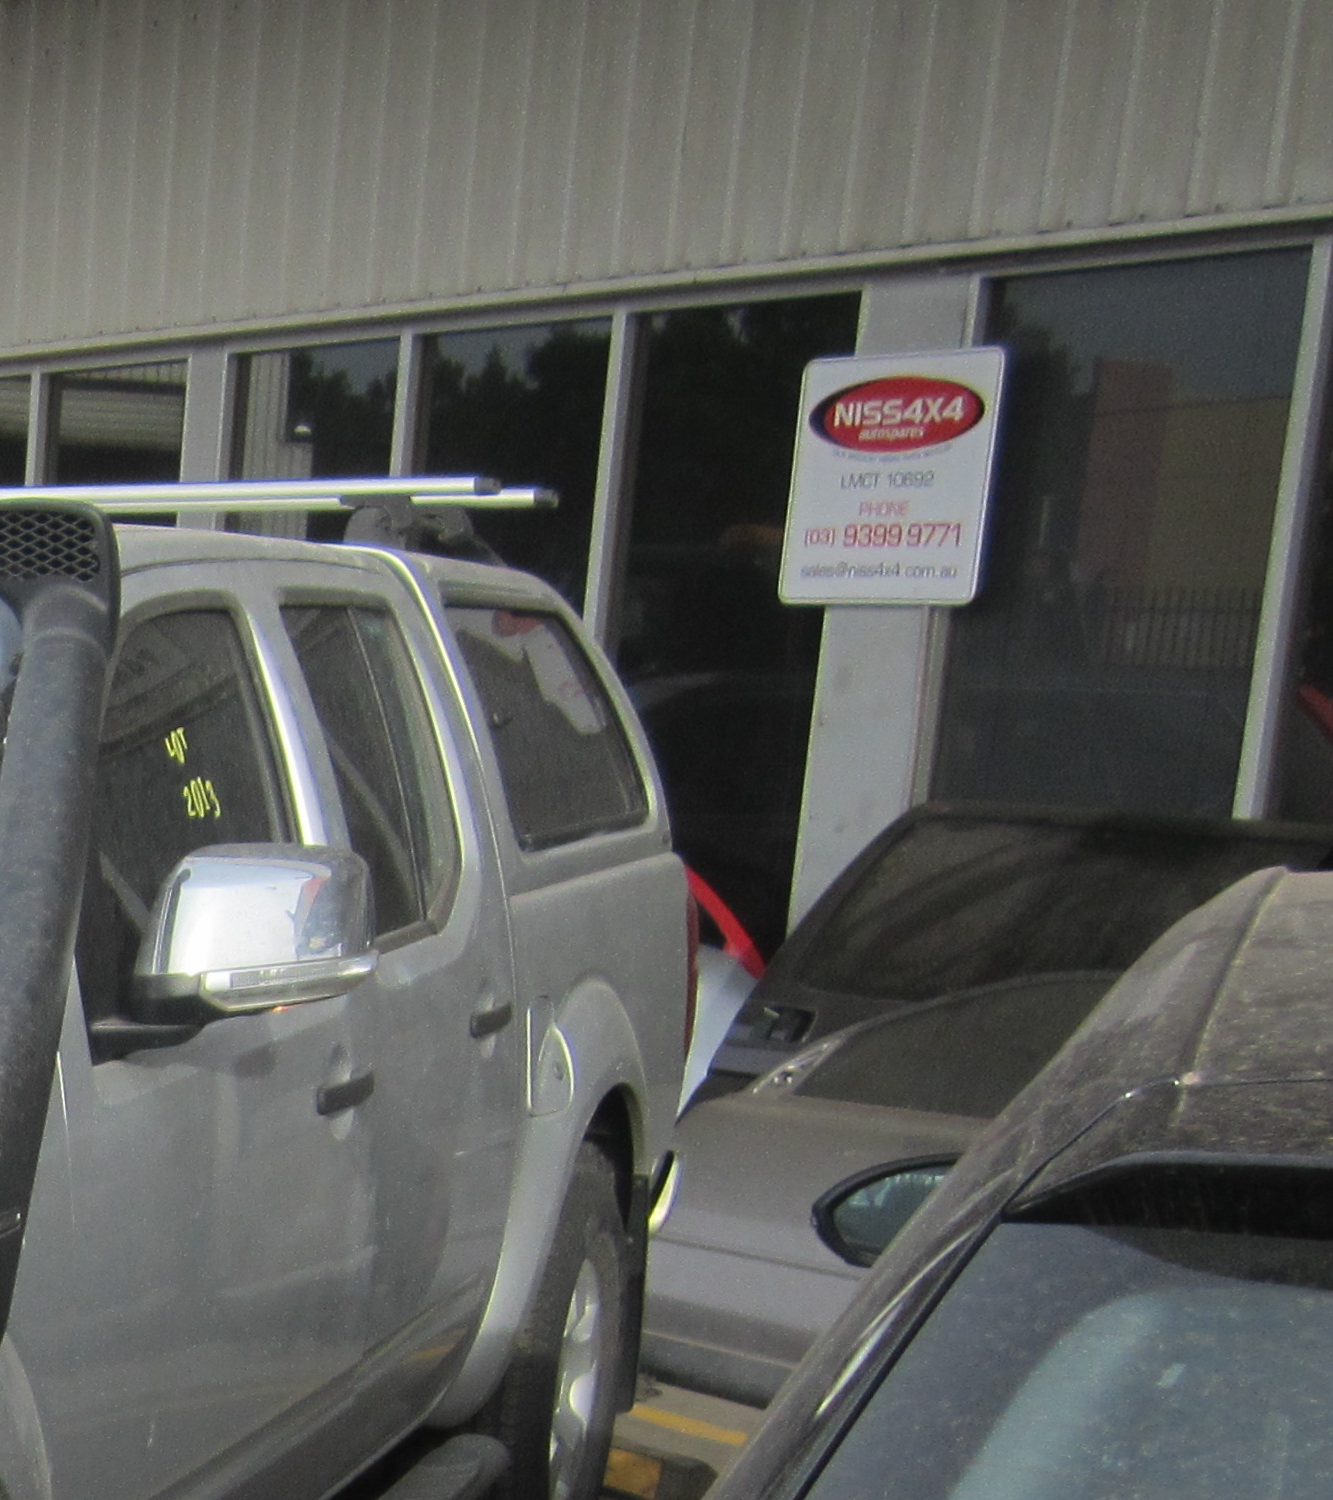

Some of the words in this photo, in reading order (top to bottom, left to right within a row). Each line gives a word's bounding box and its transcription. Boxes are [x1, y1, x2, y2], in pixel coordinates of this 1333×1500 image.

[834, 397, 964, 427] NISS4X4
[858, 426, 925, 441] autospares
[840, 473, 880, 489] LMCT
[858, 502, 910, 517] PHONE
[804, 528, 836, 548] (03)
[843, 523, 903, 547] 9399
[906, 522, 962, 547] 9771
